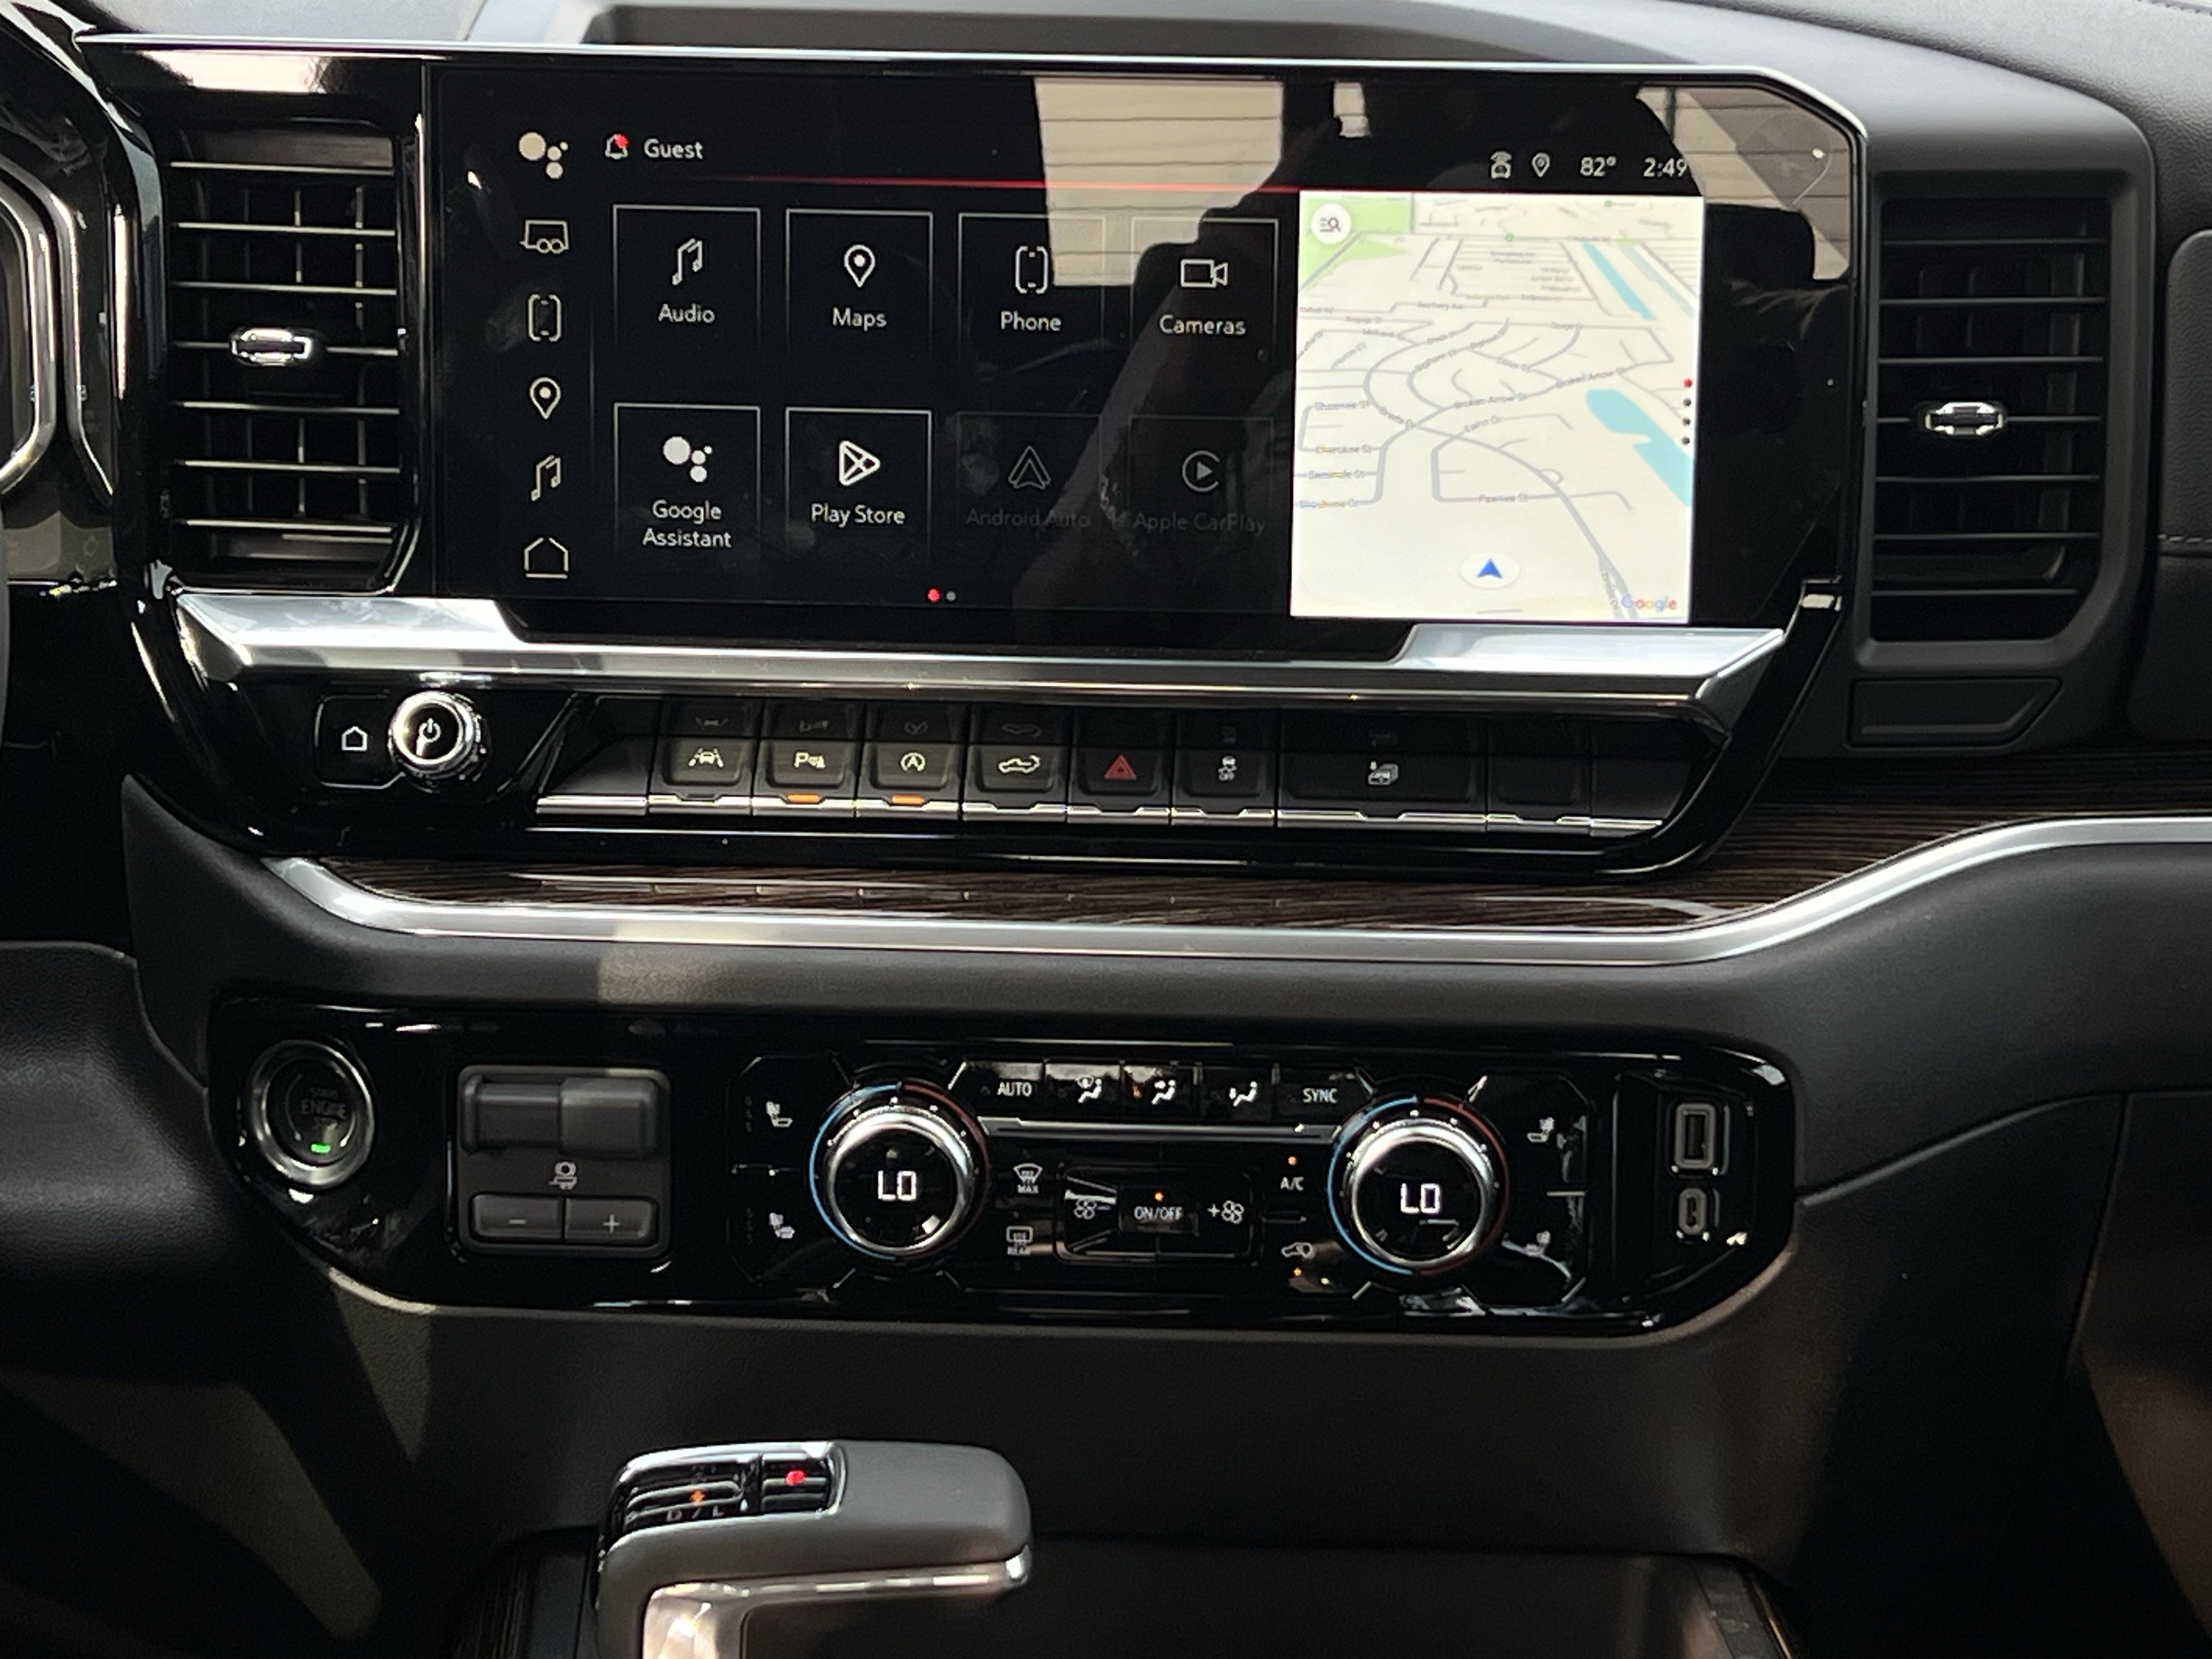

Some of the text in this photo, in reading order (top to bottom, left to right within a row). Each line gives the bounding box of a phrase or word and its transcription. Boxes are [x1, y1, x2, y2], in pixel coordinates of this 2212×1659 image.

[644, 138, 703, 160] Guest
[1580, 156, 1617, 177] 82°
[1643, 156, 1688, 177] 2:49
[658, 303, 715, 323] Audio
[833, 307, 887, 331] Maps
[1001, 311, 1062, 331] Phone
[1160, 314, 1246, 335] Cameras
[653, 500, 721, 524] Google
[811, 503, 905, 528] Play Store
[966, 508, 1090, 528] Android Auto
[1133, 512, 1266, 536] Apple CarPlay
[642, 528, 731, 548] Assistant
[1621, 593, 1677, 612] Google
[997, 1081, 1032, 1097] AUTO
[1303, 1088, 1338, 1103] SYNC
[877, 1170, 917, 1201] LO
[1280, 1177, 1304, 1191] A/C
[1400, 1183, 1441, 1214] LO
[1134, 1206, 1182, 1221] ON/OFF
